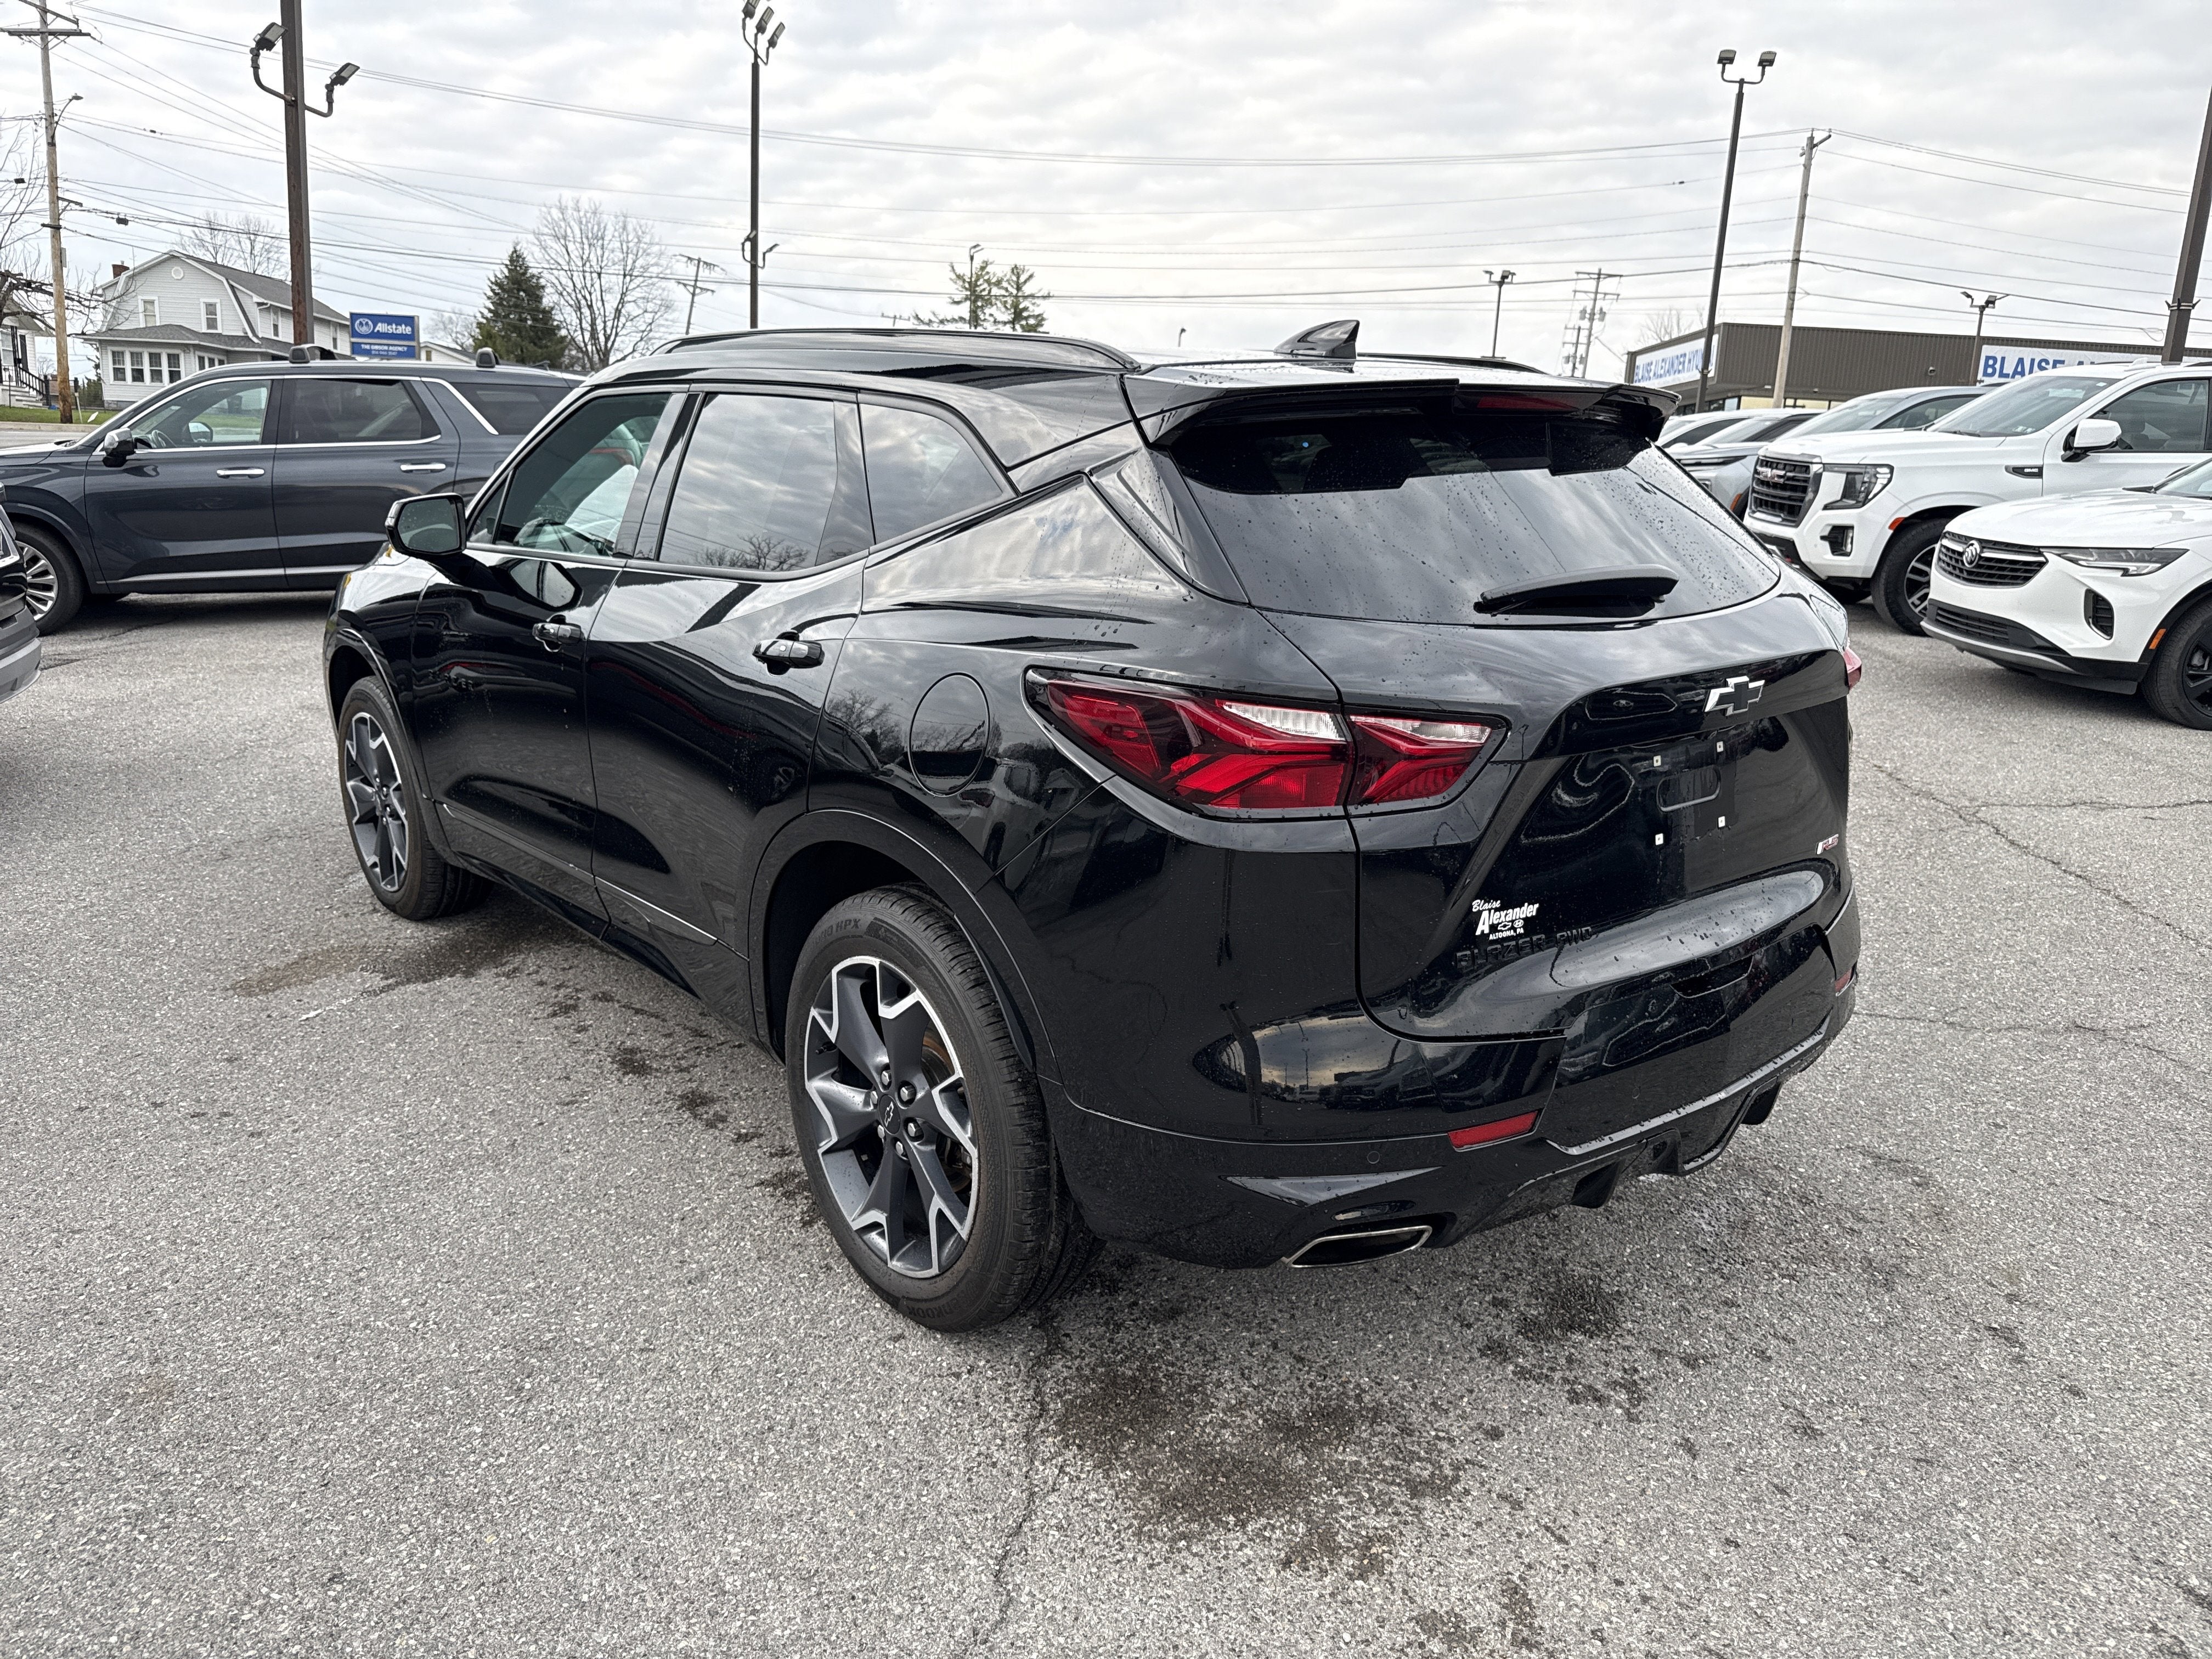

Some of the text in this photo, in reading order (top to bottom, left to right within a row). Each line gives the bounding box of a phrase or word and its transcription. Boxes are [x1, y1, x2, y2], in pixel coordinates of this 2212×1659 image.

[374, 322, 412, 335] Allstate
[1634, 360, 1653, 383] BLAISE
[1652, 353, 1687, 379] ALEXANDER
[1816, 833, 1839, 855] RS
[1472, 899, 1501, 912] Blaise
[1475, 902, 1539, 935] Alexander
[1489, 929, 1516, 940] ALTOONA,
